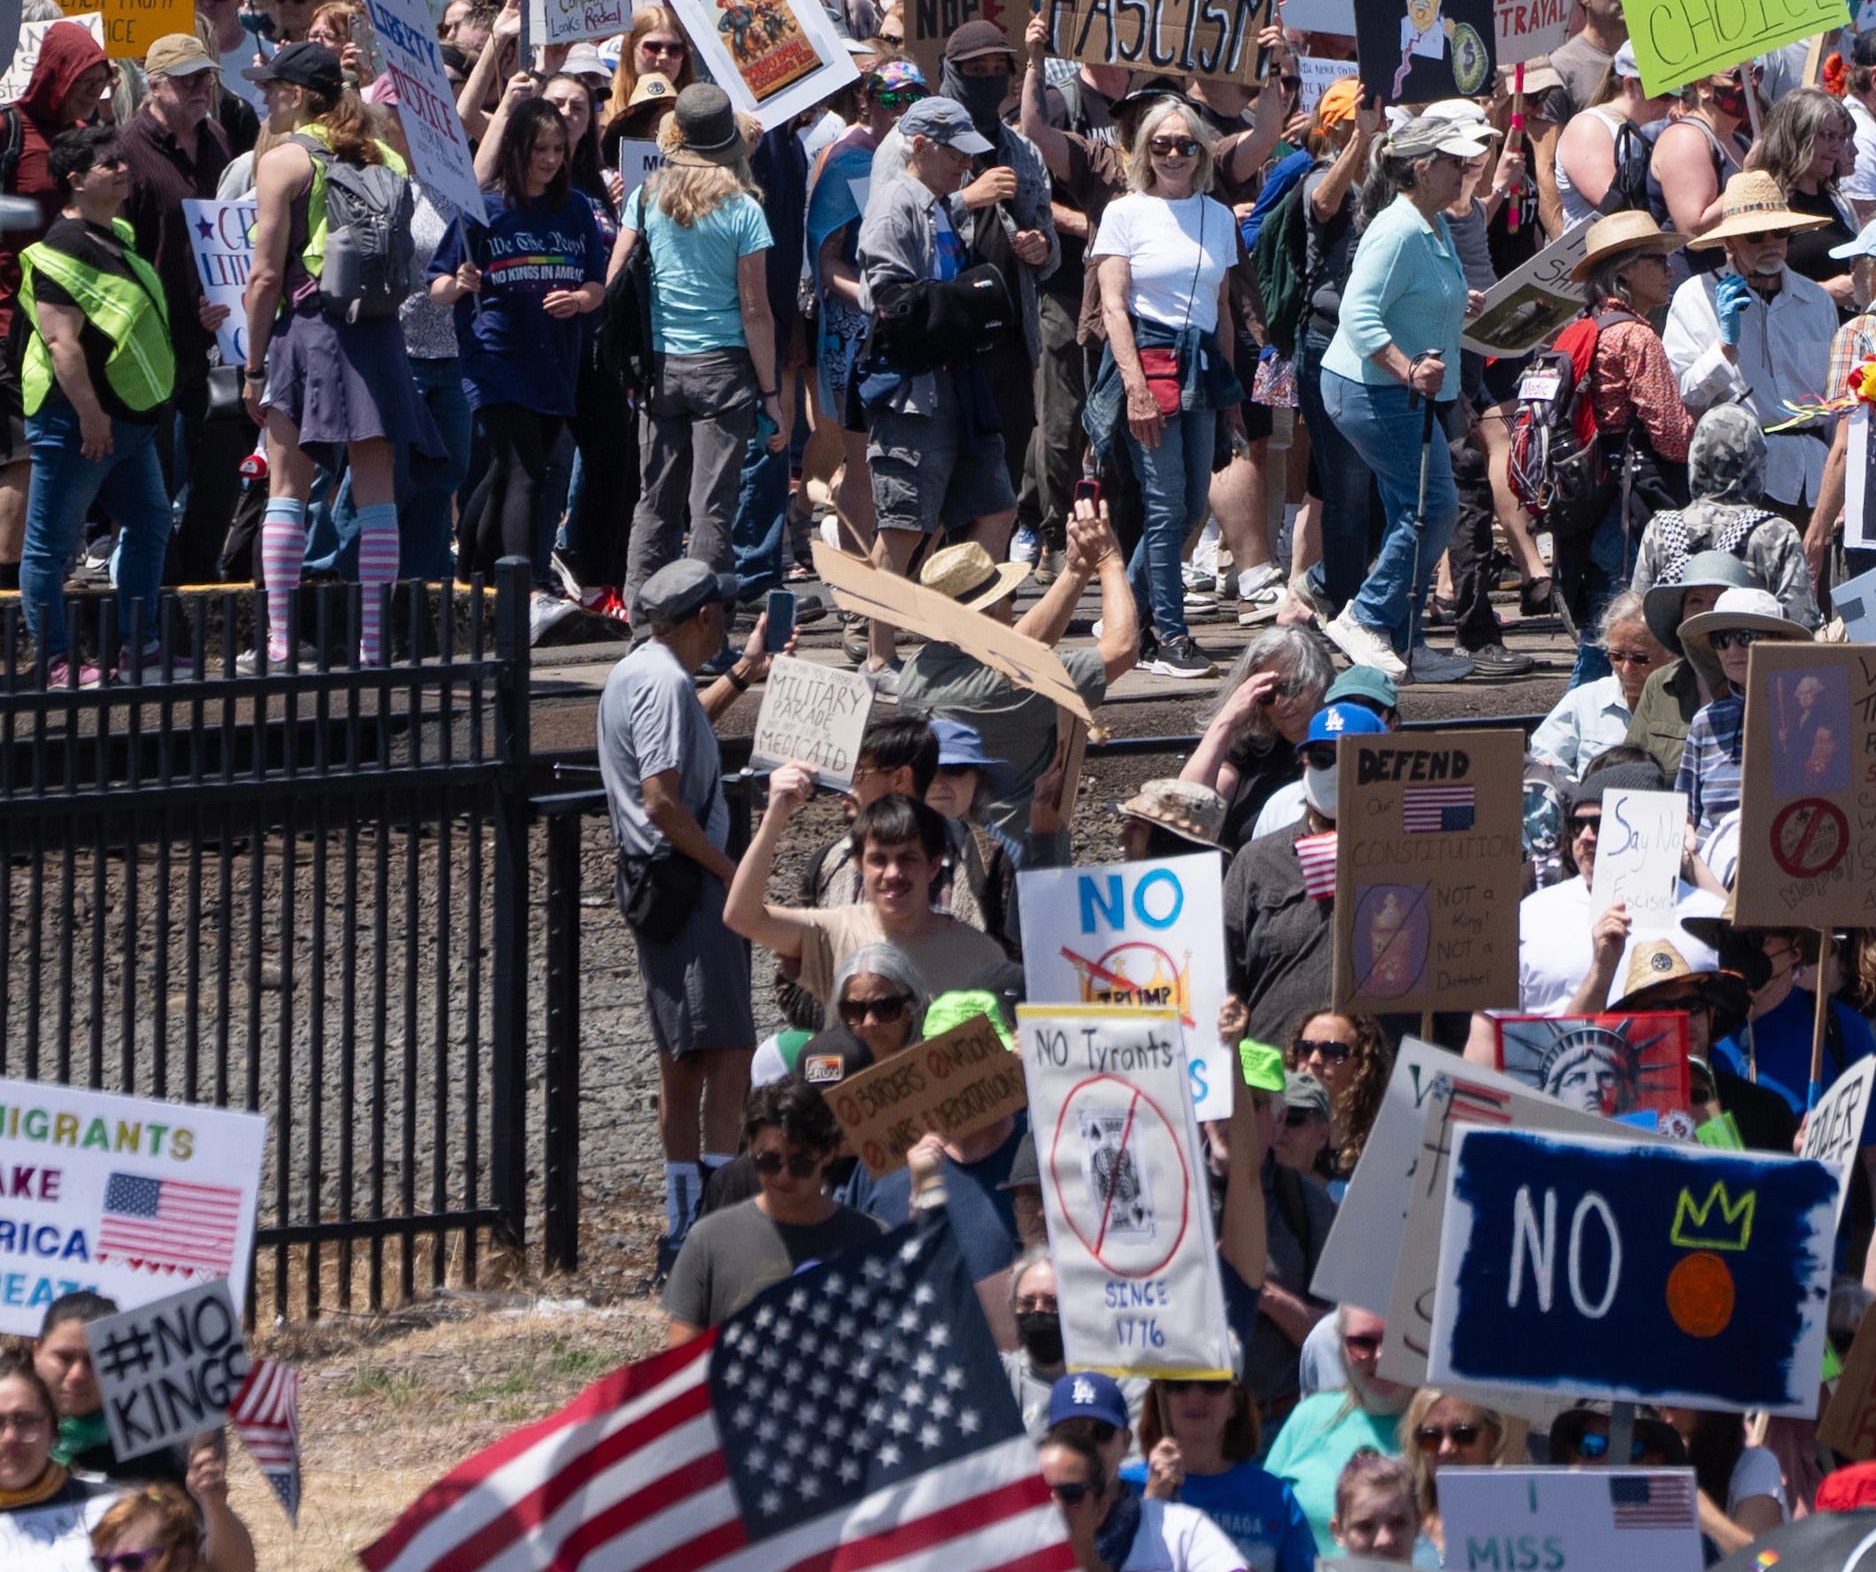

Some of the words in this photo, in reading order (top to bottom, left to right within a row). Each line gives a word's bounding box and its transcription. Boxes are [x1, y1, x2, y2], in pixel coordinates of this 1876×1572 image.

[769, 674, 864, 714] MILITARY
[759, 730, 849, 773] MEDICAID
[1358, 749, 1471, 784] DEFEND
[1079, 868, 1184, 934] NO
[1035, 1029, 1069, 1066] NO
[1082, 1032, 1174, 1072] Tyrants
[1508, 1184, 1623, 1319] NO
[1105, 1281, 1168, 1309] SINCE
[100, 1296, 232, 1380] #NO
[1115, 1319, 1165, 1349] 1776
[108, 1348, 250, 1453] KINGS
[1466, 1536, 1566, 1570] MISS
